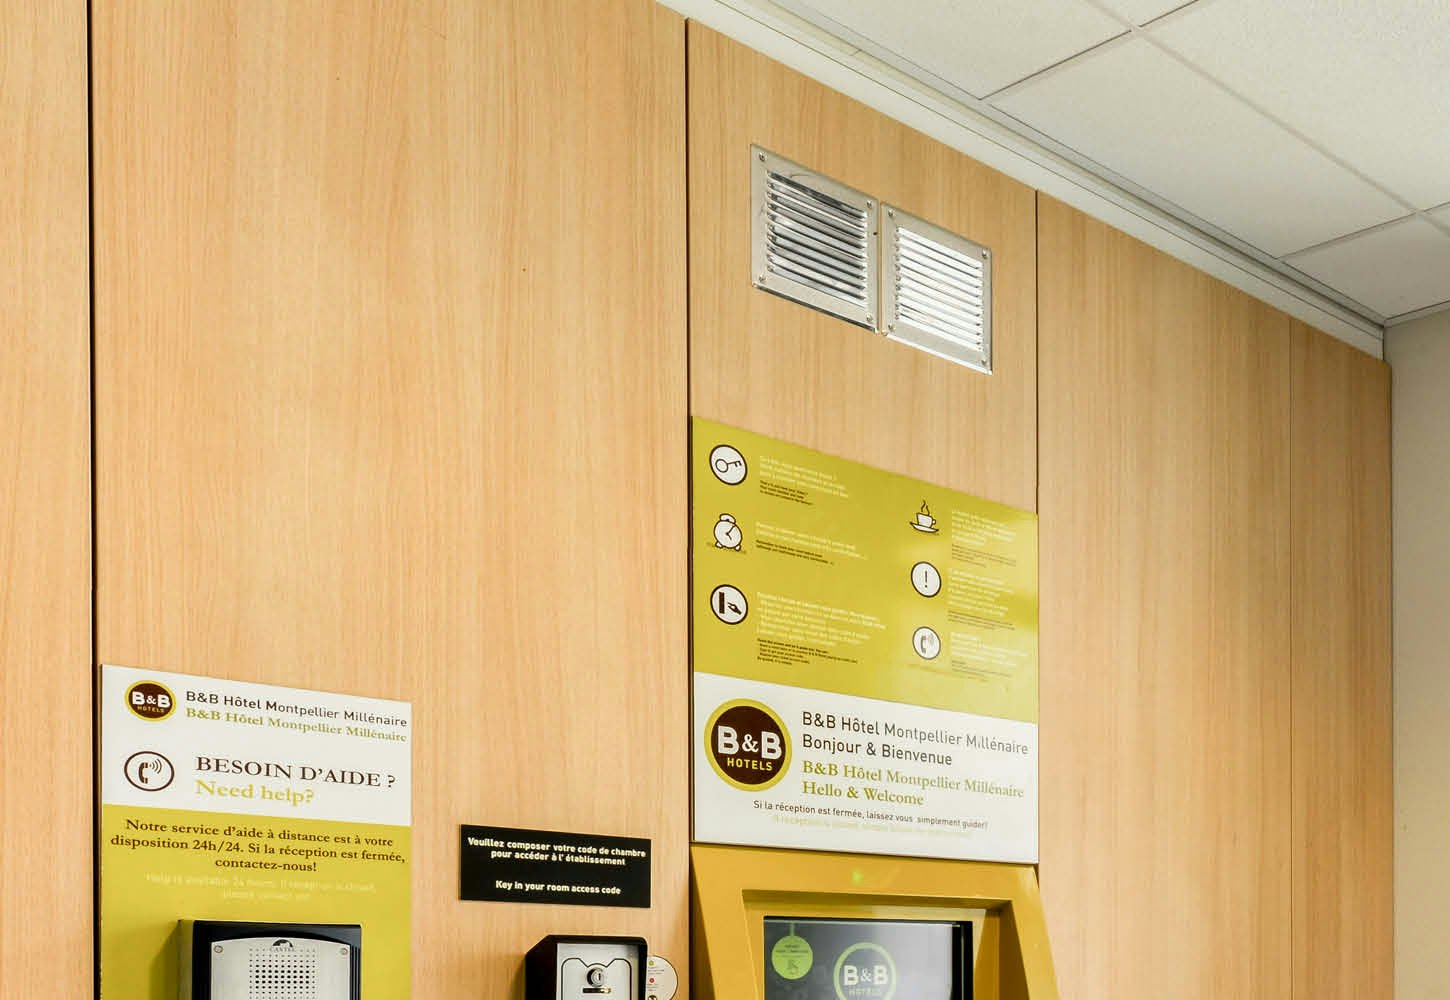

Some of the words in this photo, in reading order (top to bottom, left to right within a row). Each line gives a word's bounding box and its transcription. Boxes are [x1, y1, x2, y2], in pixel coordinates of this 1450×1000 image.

[131, 690, 171, 707] B&B
[186, 690, 218, 704] B&B
[224, 695, 261, 709] Hôtel
[266, 700, 339, 719] Montpellier
[344, 710, 407, 727] Millénaire
[186, 707, 220, 720] B&B
[225, 711, 263, 726] Hôtel
[267, 716, 342, 735] Montpellier
[346, 726, 407, 742] Millénaire
[803, 711, 836, 730] B&B
[841, 716, 880, 736] Hôtel
[884, 723, 962, 745] Montpellier
[966, 734, 1029, 756] Millénaire
[717, 725, 782, 760] B&B
[803, 734, 862, 755] Bonjour
[866, 743, 877, 756] &
[882, 743, 953, 766] Bienvenue
[196, 756, 291, 779] BESOIN
[387, 774, 396, 788] ?
[727, 757, 773, 772] HOTELS
[196, 780, 253, 799] Need
[261, 783, 314, 807] help?
[802, 781, 842, 798] Hello
[847, 785, 859, 800] &
[864, 788, 924, 806] Welcome
[803, 760, 839, 777] B&B
[843, 764, 882, 783] Hôtel
[886, 769, 961, 792] Montpellier
[964, 778, 1024, 799] Millénaire
[753, 800, 763, 809] Si
[764, 801, 773, 810] la
[775, 803, 816, 815] réception
[817, 806, 831, 815] est
[832, 807, 865, 819] fermée,
[866, 811, 894, 822] laissez
[896, 815, 913, 823] vous
[917, 815, 961, 828] simplement
[126, 819, 167, 832] Notre
[172, 825, 219, 835] service
[267, 829, 274, 839] à
[278, 830, 330, 843] distance
[334, 836, 351, 844] est
[354, 835, 361, 845] à
[365, 837, 393, 847] votre
[110, 835, 189, 850] disposition
[192, 839, 244, 853] 24h/24.
[248, 842, 260, 853] Si
[264, 844, 275, 854] la
[279, 845, 337, 859] réception
[341, 851, 358, 859] est
[361, 850, 405, 863] fermée,
[467, 837, 505, 848] Veuillez
[507, 841, 551, 851] composer
[553, 844, 576, 853] votre
[577, 846, 598, 854] code
[599, 847, 610, 855] de
[611, 848, 646, 858] chambre
[490, 850, 513, 859] pour
[514, 851, 550, 860] accéder
[551, 852, 558, 861] à
[565, 854, 626, 866] établissement
[215, 859, 317, 872] contactez-nous!
[495, 880, 513, 891] Key
[524, 883, 545, 891] your
[546, 884, 570, 892] room
[571, 886, 600, 894] access
[601, 886, 622, 895] code
[843, 965, 888, 985] B&B
